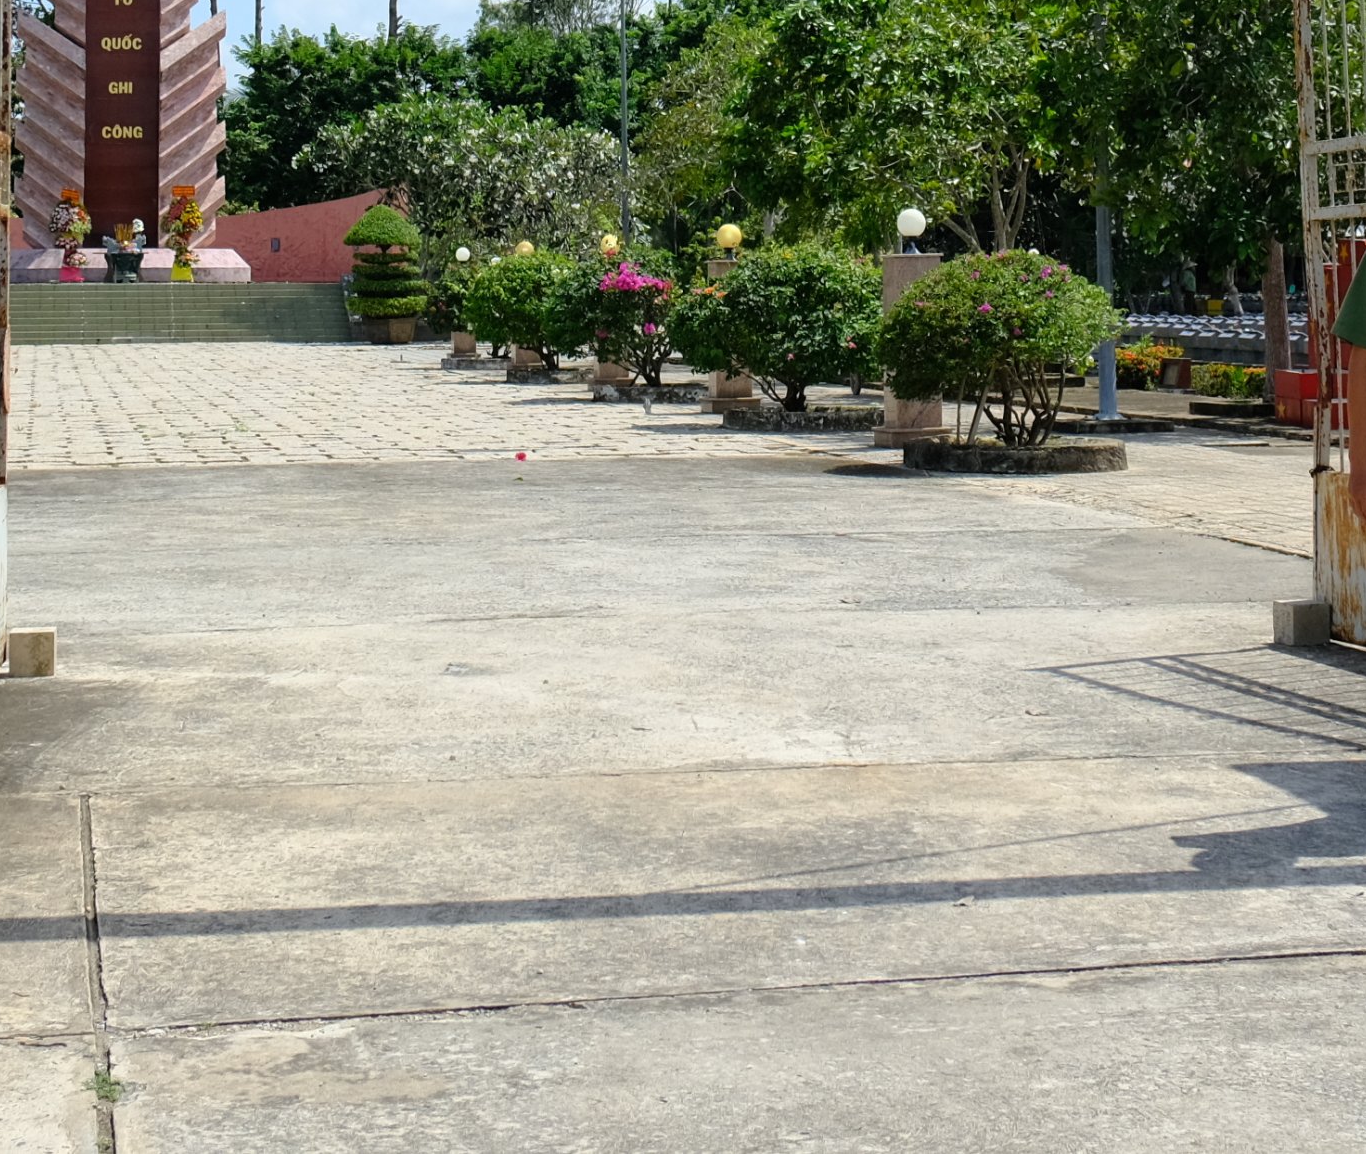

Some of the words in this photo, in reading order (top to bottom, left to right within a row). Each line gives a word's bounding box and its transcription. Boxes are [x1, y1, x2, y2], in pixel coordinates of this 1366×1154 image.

[101, 33, 142, 52] QUỐC
[108, 81, 133, 95] GHI
[101, 124, 143, 139] CÔNG
